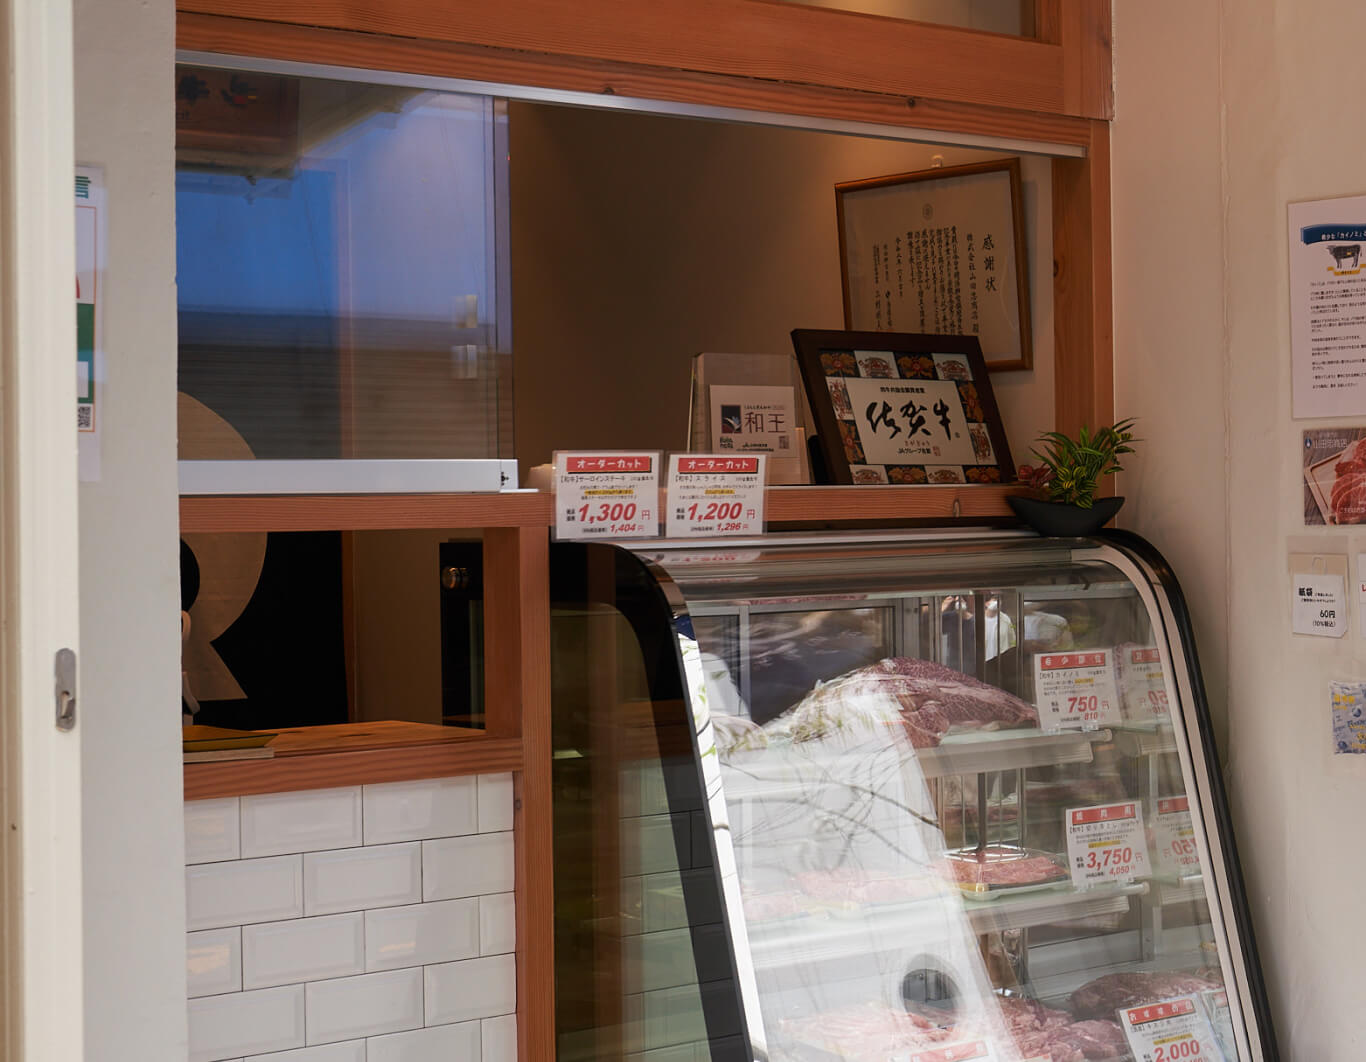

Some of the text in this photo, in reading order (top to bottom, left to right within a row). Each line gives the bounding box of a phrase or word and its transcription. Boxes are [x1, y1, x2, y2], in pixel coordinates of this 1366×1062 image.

[983, 233, 997, 292] 感謝状
[744, 411, 787, 434] 和王
[866, 398, 952, 441] 佐賀牛
[577, 460, 642, 469] オーダーカット
[688, 460, 749, 470] オーダーカット
[578, 503, 637, 524] 1,300
[641, 509, 651, 520] 円
[687, 502, 743, 523] 1,200
[746, 509, 756, 520] 円
[609, 523, 636, 534] 1,404
[716, 522, 741, 532] 1,296
[1298, 587, 1313, 597] 紙袋
[1319, 609, 1336, 619] 60円
[1067, 695, 1098, 714] 750
[1087, 846, 1132, 871] 3,750
[1109, 865, 1130, 877] 4,050
[1153, 1039, 1200, 1062] 2,000
